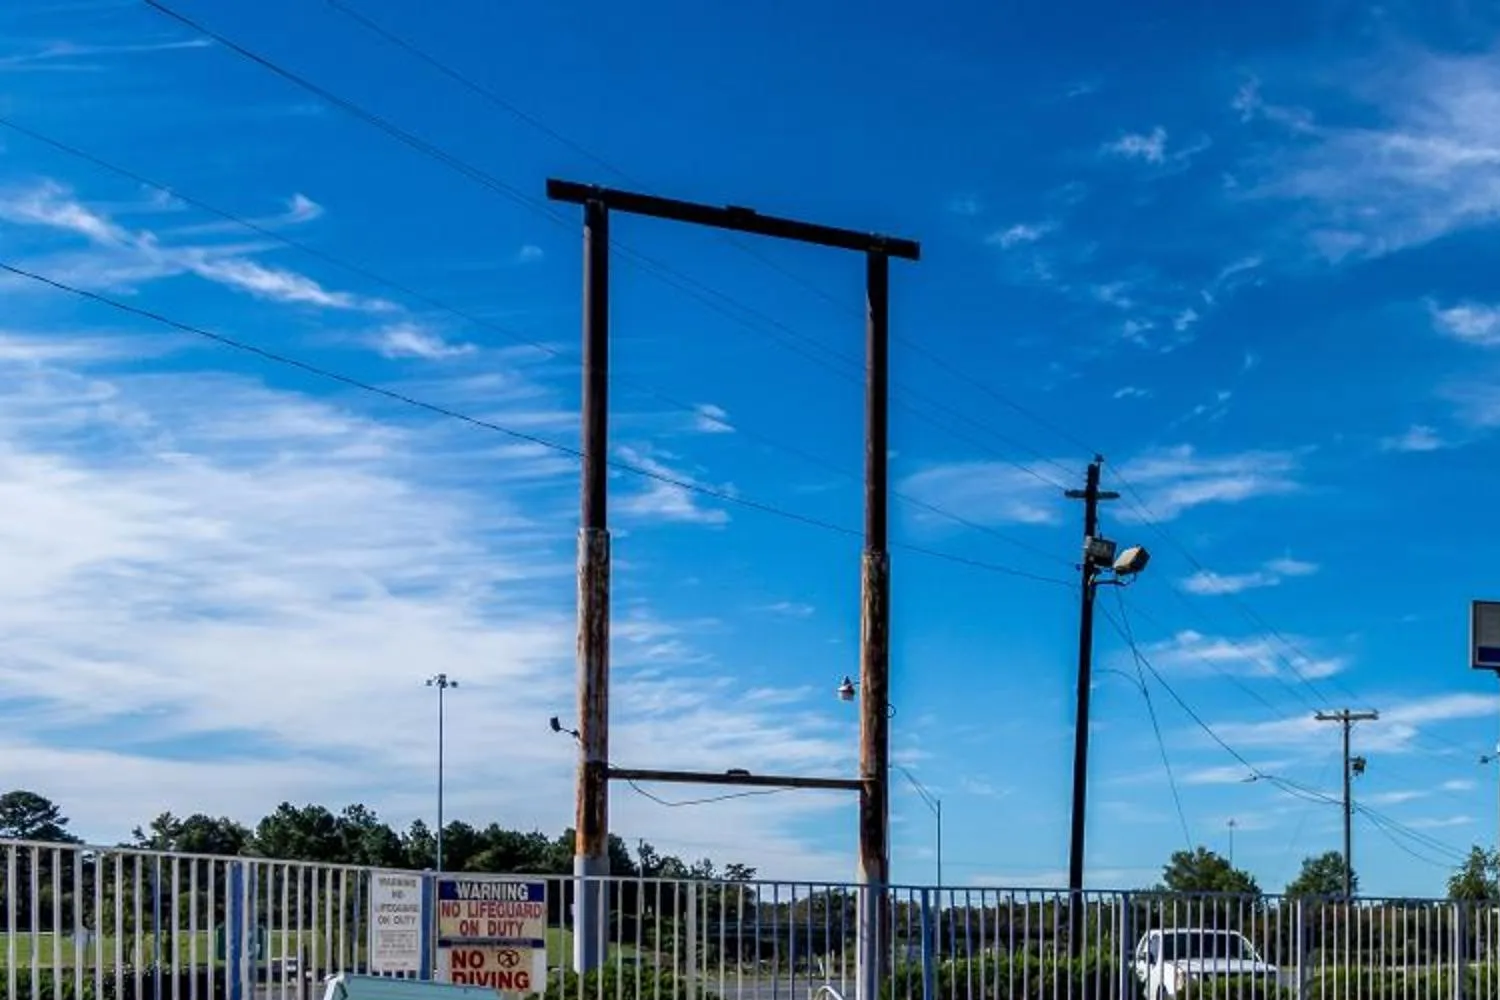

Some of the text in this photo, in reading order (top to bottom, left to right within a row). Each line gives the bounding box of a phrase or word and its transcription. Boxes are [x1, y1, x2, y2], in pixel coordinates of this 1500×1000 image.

[455, 882, 529, 900] WARNING
[441, 903, 543, 918] NO LIFEGUARD
[460, 921, 524, 936] ON DUTY
[452, 951, 485, 969] NO
[452, 971, 530, 989] DIVING
